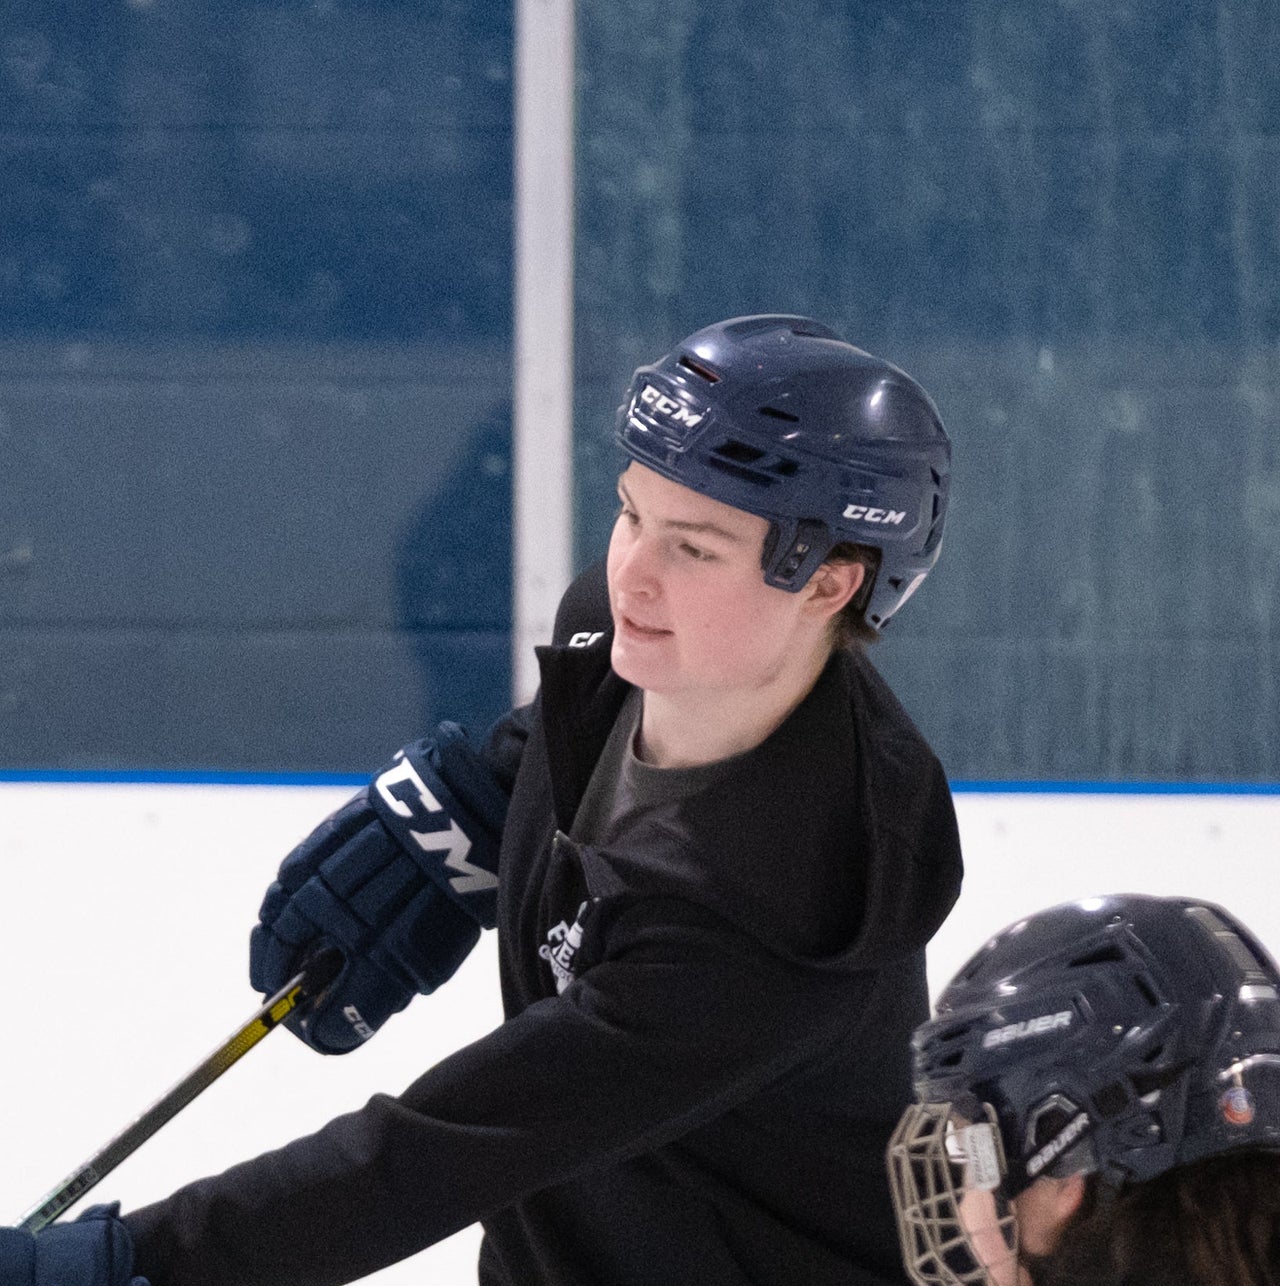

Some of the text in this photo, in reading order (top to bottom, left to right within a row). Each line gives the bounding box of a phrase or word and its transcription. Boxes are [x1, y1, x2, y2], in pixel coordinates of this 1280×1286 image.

[640, 384, 703, 429] CCM
[841, 504, 907, 526] CCM
[375, 750, 501, 894] CM
[981, 1010, 1073, 1048] BAUER
[1026, 1112, 1091, 1176] BAUER
